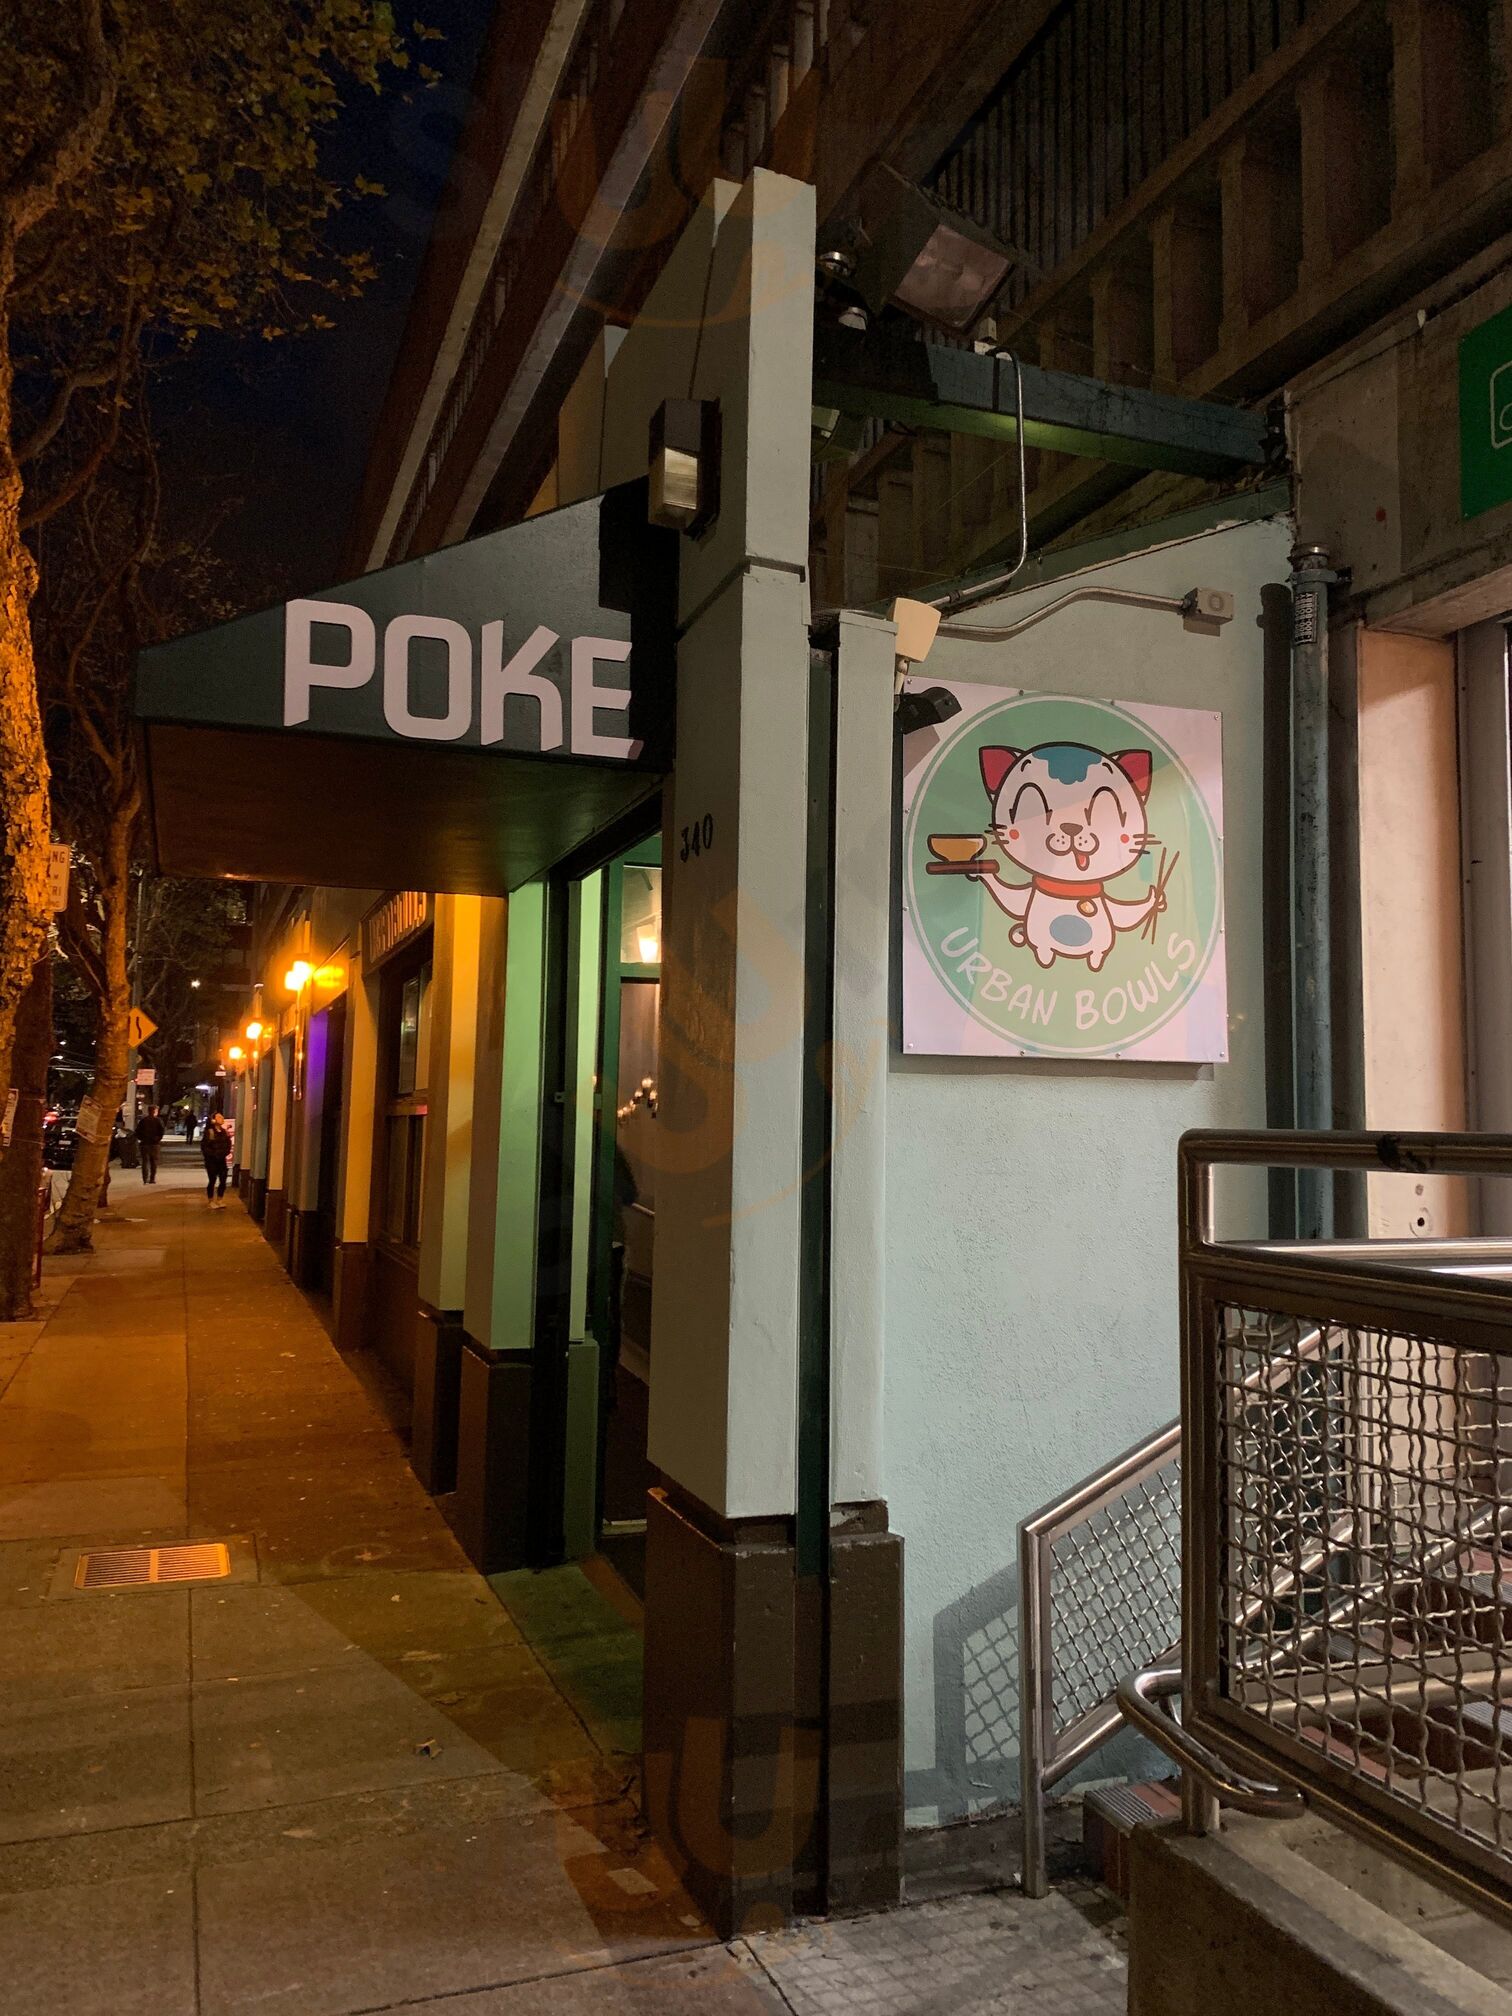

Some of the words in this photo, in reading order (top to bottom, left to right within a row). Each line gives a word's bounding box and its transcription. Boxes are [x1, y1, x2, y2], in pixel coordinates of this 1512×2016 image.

[283, 598, 643, 760] POKE
[680, 812, 713, 863] 340
[940, 927, 1058, 1025] URBAN
[1075, 932, 1196, 1030] BOWLS
